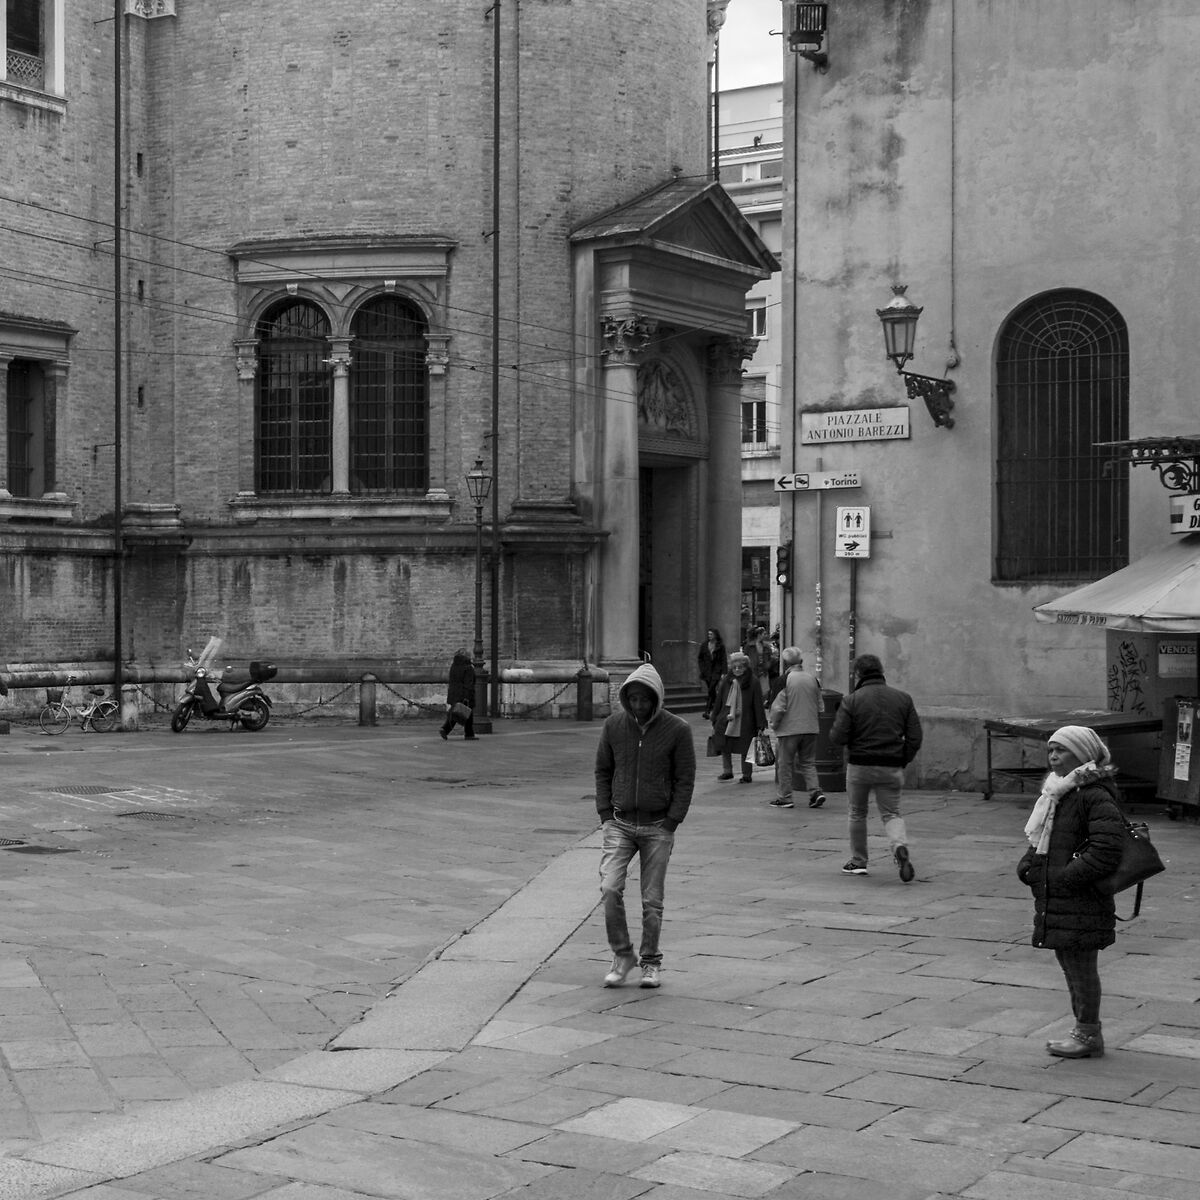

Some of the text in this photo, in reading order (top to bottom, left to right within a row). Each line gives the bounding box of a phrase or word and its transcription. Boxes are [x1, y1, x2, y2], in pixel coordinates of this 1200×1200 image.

[827, 413, 881, 426] PIAZZALE
[807, 425, 904, 440] ANTONIO BAREZZI
[830, 478, 858, 486] Torino
